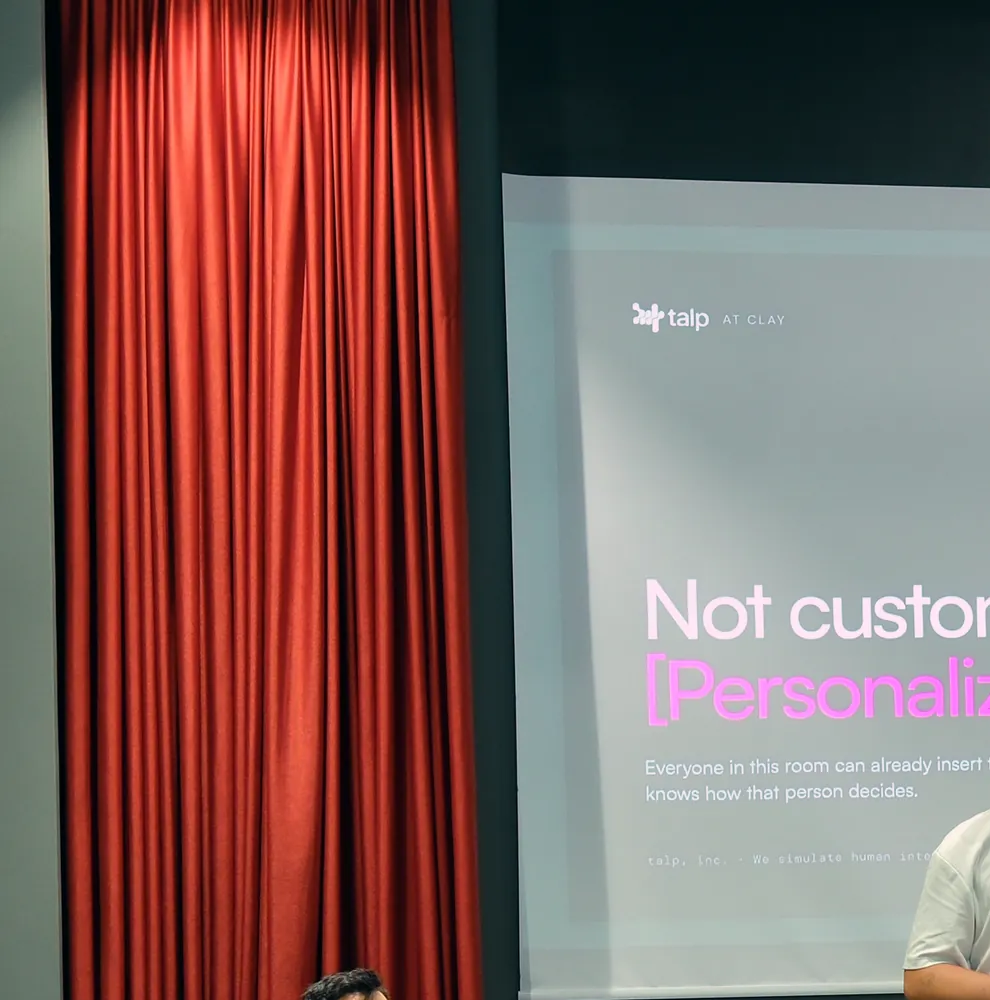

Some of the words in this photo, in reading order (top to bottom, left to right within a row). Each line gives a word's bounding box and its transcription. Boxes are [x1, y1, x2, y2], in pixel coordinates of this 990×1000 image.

[667, 307, 710, 332] talp
[722, 314, 740, 325] AT
[746, 314, 785, 326] CLAY
[646, 578, 772, 640] Not
[645, 759, 725, 779] Everyone
[729, 759, 745, 775] in
[750, 758, 780, 775] this
[785, 761, 830, 774] room
[834, 761, 866, 773] can
[870, 756, 933, 776] already
[936, 756, 983, 772] insert
[646, 785, 700, 801] knows
[705, 785, 742, 801] how
[746, 784, 780, 801] that
[785, 786, 844, 804] person
[848, 782, 918, 799] decides.
[648, 854, 686, 868] talp,
[778, 852, 842, 864] simulate
[851, 851, 891, 862] human
